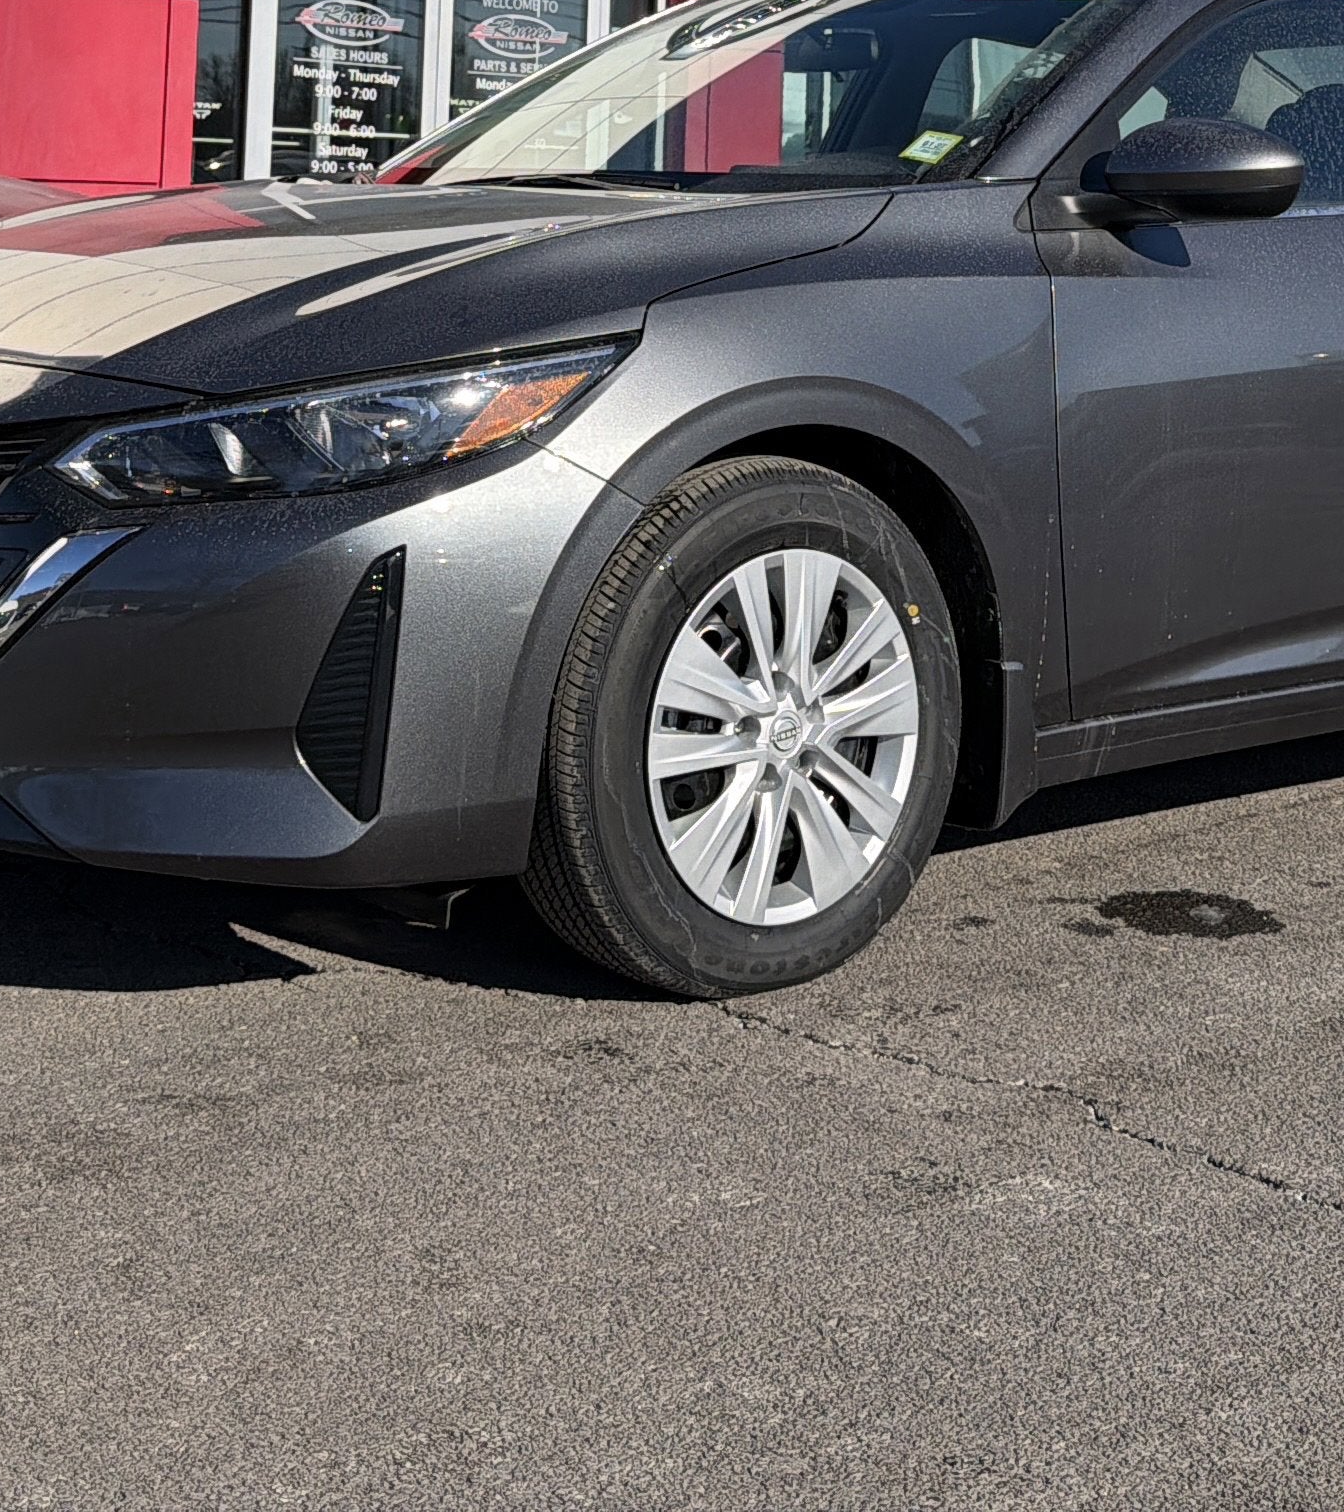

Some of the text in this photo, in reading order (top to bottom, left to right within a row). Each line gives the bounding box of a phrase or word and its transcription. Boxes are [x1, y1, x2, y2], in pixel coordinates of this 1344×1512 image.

[319, 1, 388, 28] Romeo
[542, 0, 559, 14] TO
[324, 26, 375, 40] NISSAN
[492, 17, 552, 40] Romeo
[495, 40, 541, 52] NISSAN
[349, 50, 389, 64] HOURS
[473, 59, 508, 73] PARTS
[509, 61, 518, 73] &
[293, 63, 339, 83] Monday
[348, 68, 401, 88] Thursday
[315, 84, 342, 99] 9:00
[351, 87, 377, 101] 7:00
[328, 105, 364, 124] Friday
[312, 122, 340, 136] 9:00
[350, 124, 376, 138] 6:00
[318, 141, 369, 160] Saturday
[310, 160, 338, 174] 9:00
